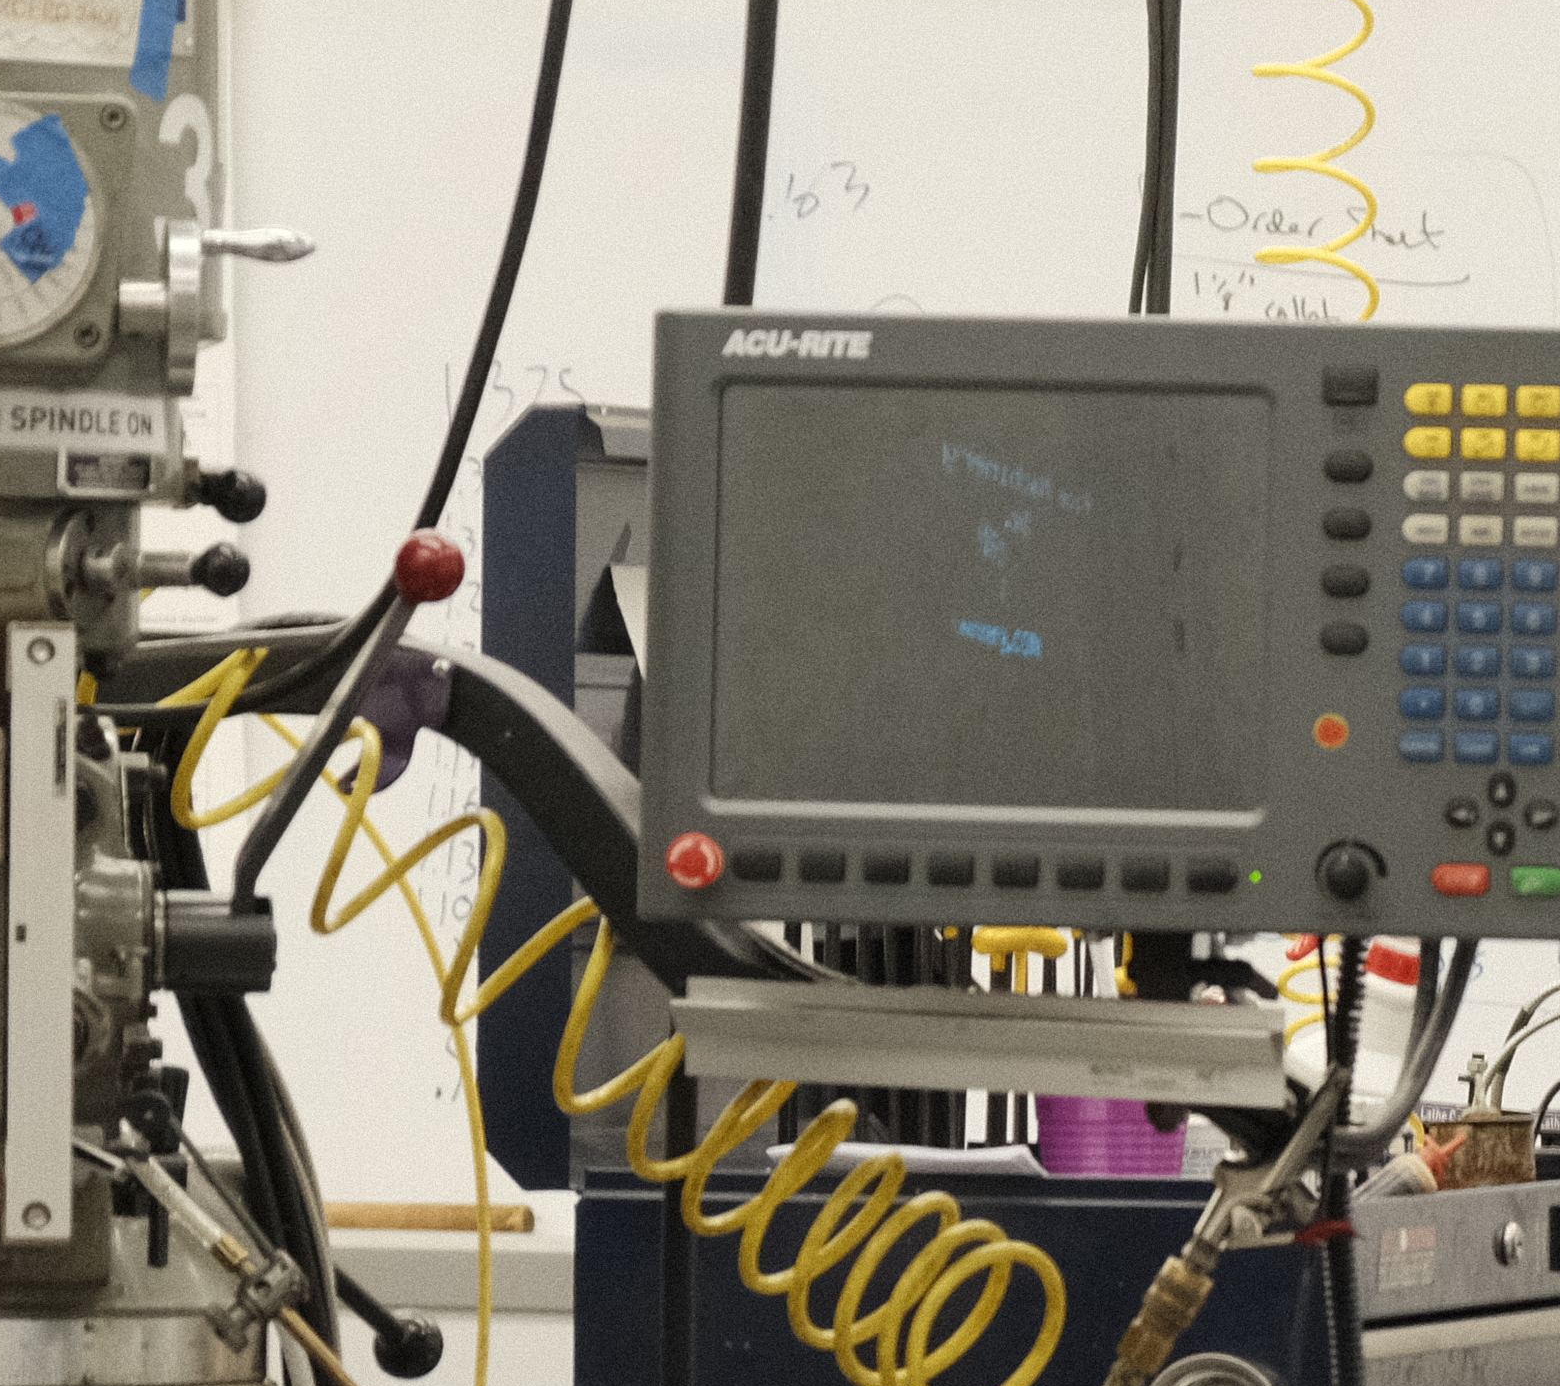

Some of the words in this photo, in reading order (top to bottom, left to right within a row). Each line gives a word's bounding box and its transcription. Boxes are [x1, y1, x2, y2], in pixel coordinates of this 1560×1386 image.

[722, 329, 874, 360] ACU-RITE
[10, 406, 121, 436] SPINDLE
[127, 414, 154, 436] ON
